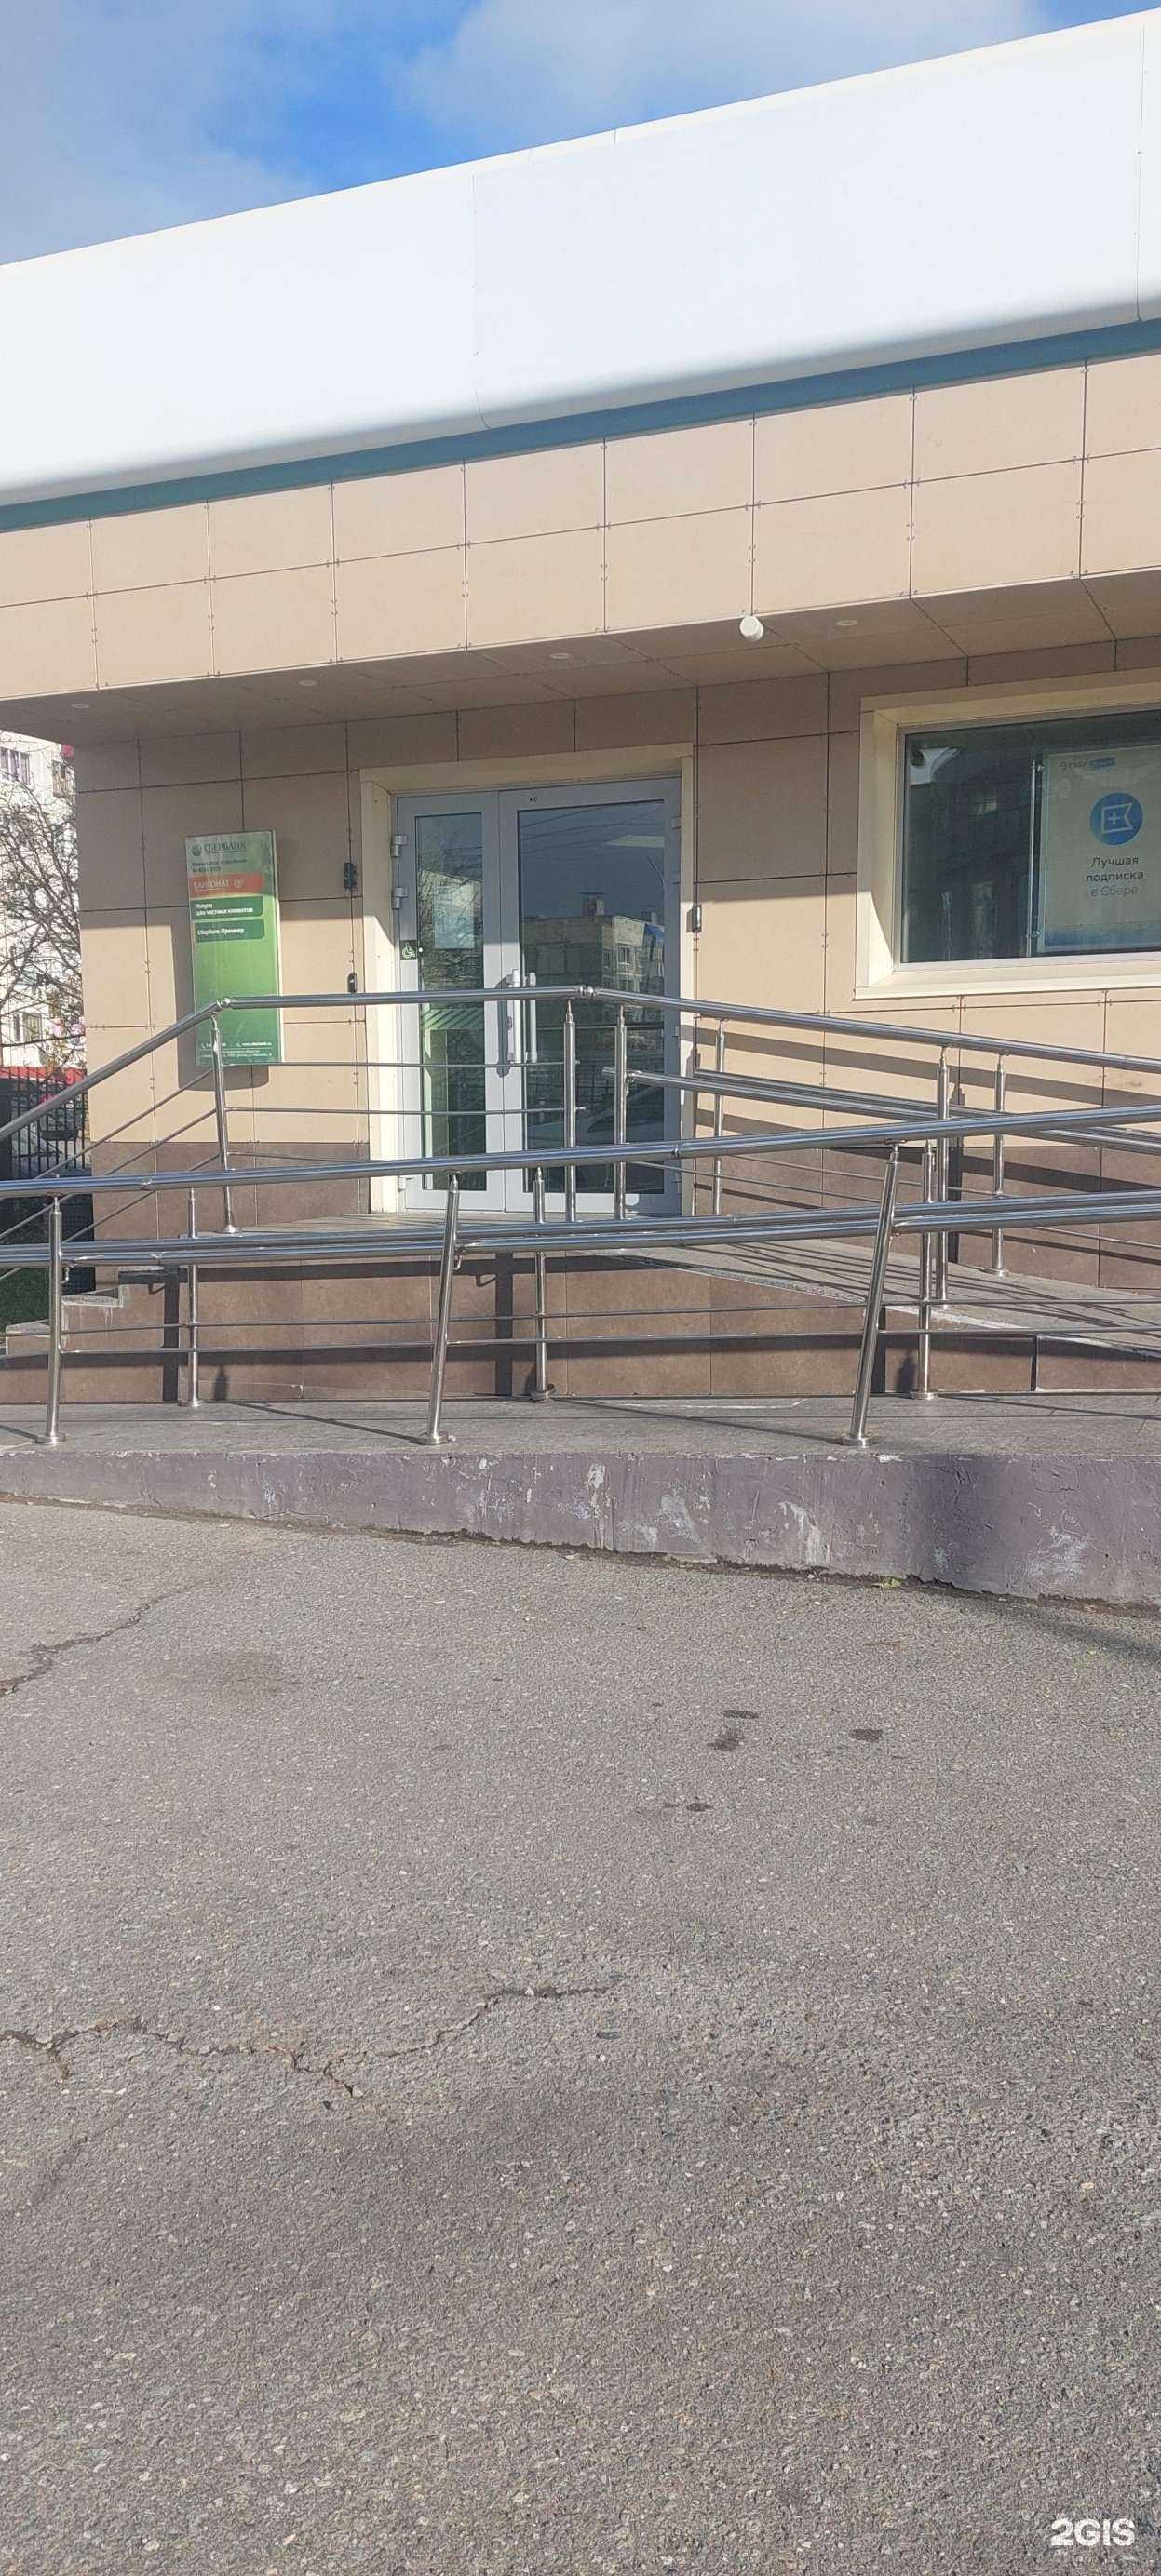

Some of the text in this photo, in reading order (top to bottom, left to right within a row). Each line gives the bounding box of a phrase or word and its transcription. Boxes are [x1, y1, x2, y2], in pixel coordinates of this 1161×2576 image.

[1091, 857, 1139, 868] Лучшая
[1087, 871, 1144, 883] подписка
[1101, 886, 1139, 897] Сбере
